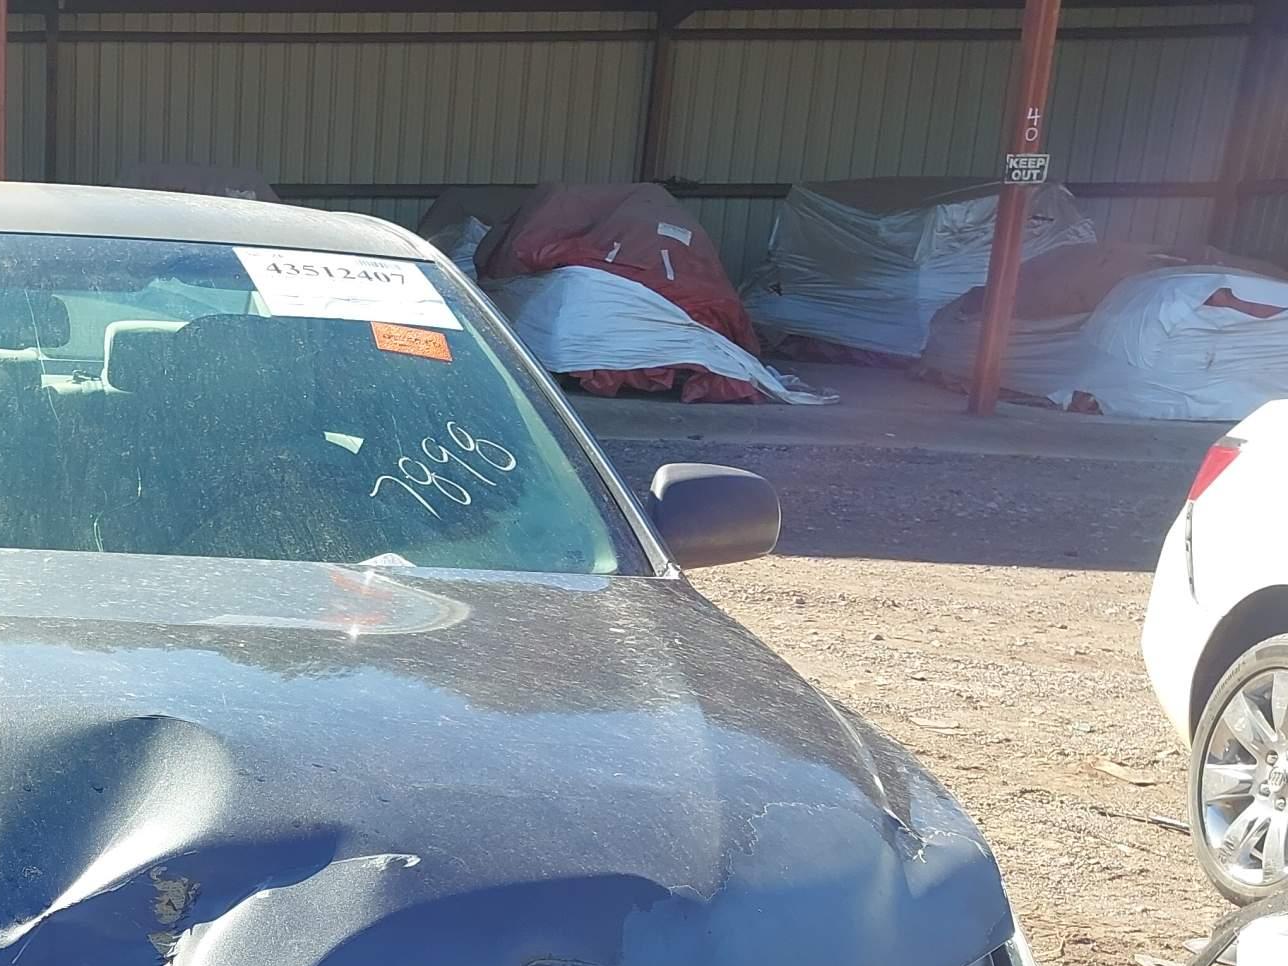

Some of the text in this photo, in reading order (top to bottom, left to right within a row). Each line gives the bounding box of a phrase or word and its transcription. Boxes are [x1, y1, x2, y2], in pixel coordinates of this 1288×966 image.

[1009, 158, 1045, 169] KEEP
[1011, 170, 1040, 181] OUT
[266, 262, 406, 286] 43512407
